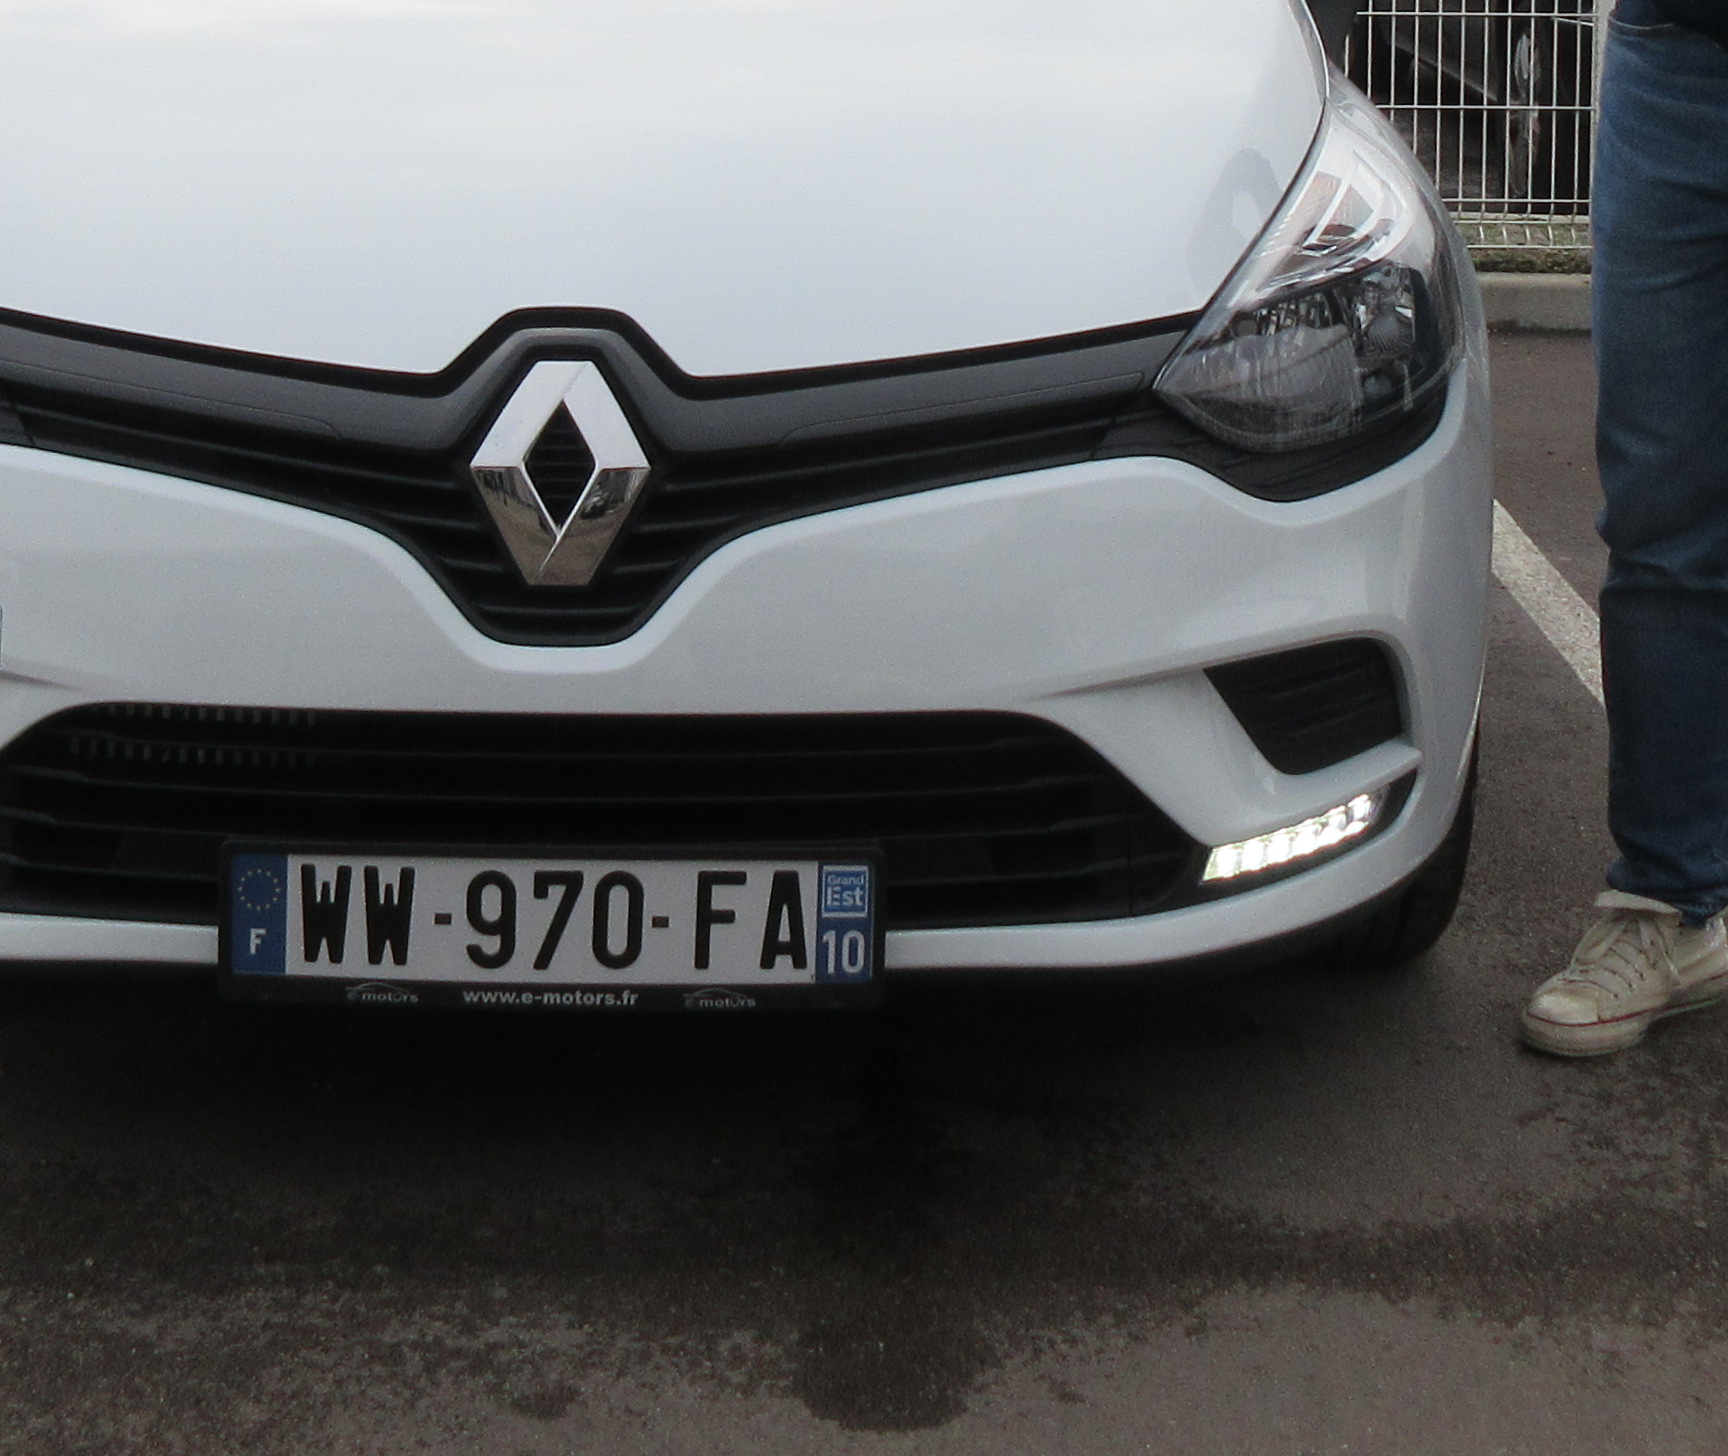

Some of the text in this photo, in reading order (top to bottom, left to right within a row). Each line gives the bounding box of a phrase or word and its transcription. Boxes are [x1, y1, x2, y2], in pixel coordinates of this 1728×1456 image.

[827, 873, 864, 886] Grand
[826, 886, 864, 907] Est
[301, 863, 807, 969] WW-970-FA
[248, 928, 267, 955] F
[823, 930, 866, 974] 10
[462, 990, 639, 1006] www.e-motors.fr
